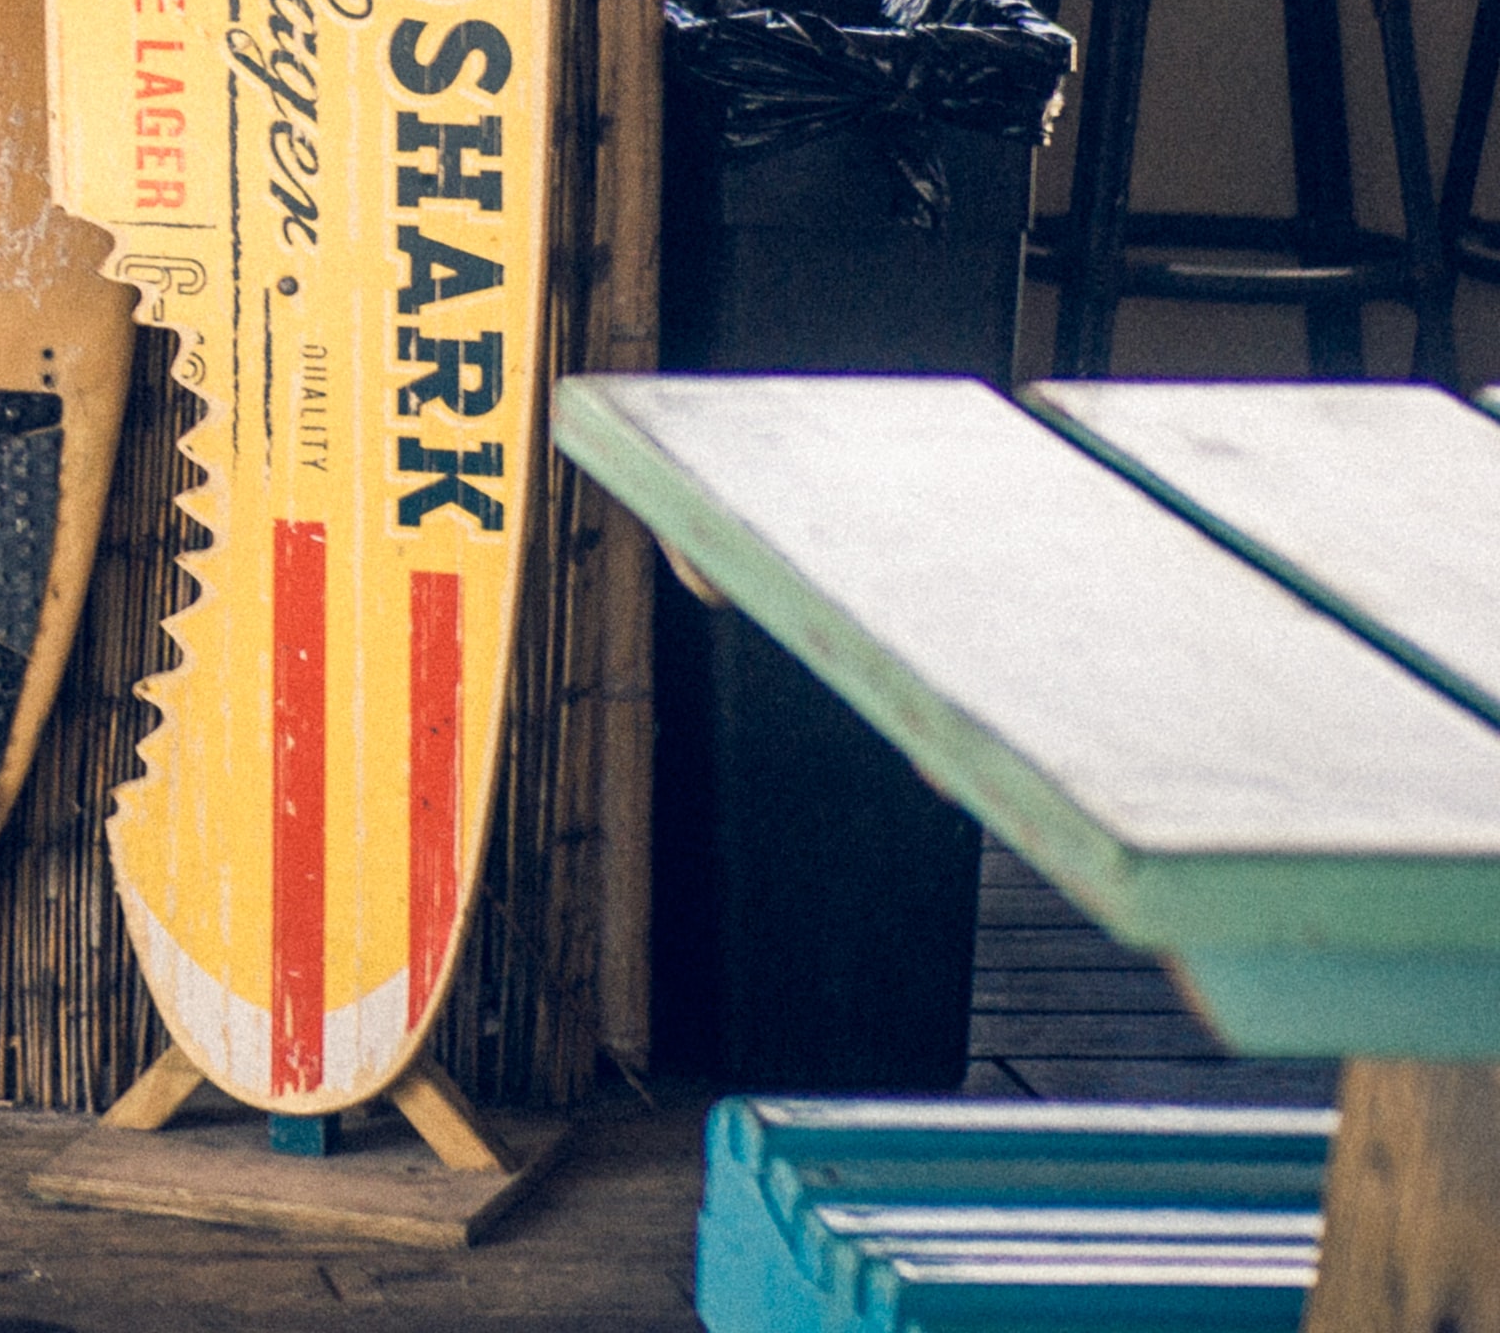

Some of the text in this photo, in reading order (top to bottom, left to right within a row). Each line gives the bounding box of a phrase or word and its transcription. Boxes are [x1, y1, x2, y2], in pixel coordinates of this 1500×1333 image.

[134, 36, 188, 212] LAGER
[116, 255, 208, 385] 6-
[301, 343, 329, 474] QUALITY
